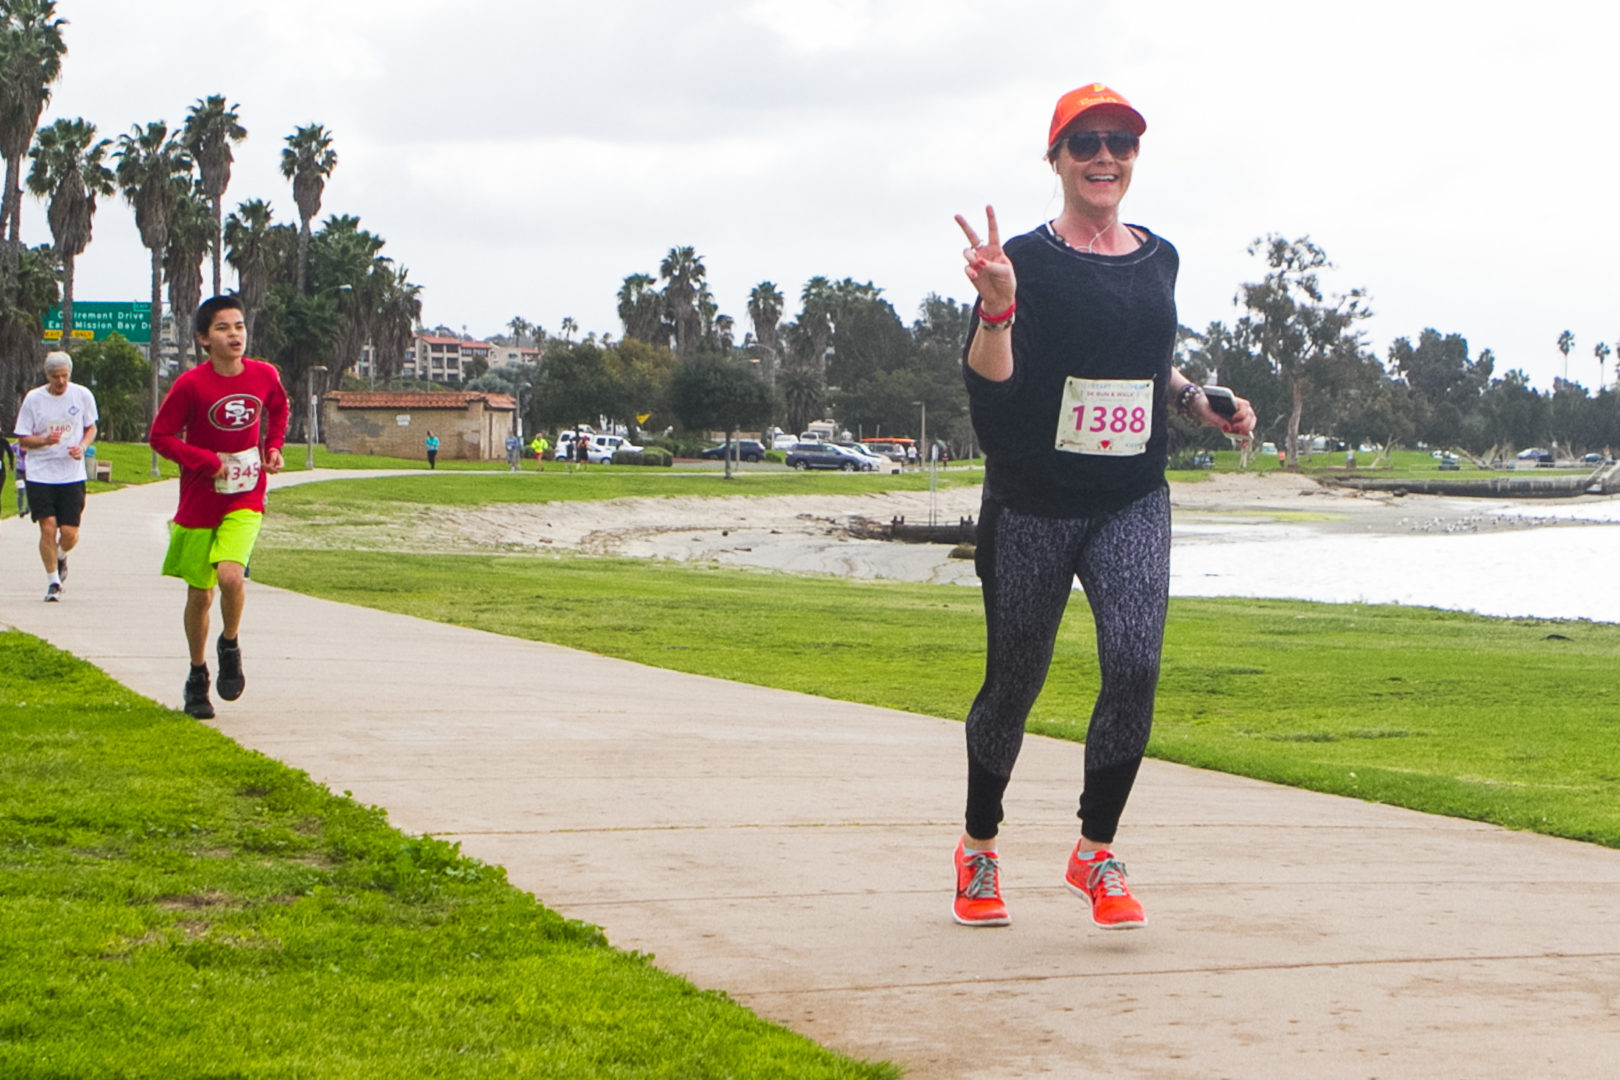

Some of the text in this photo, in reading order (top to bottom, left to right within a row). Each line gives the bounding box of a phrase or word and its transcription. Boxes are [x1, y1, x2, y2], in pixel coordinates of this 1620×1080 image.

[57, 311, 144, 320] Ciremont Drive
[75, 321, 113, 330] Mission
[117, 321, 136, 331] Bay
[1072, 404, 1146, 433] 1388
[230, 462, 260, 480] 345
